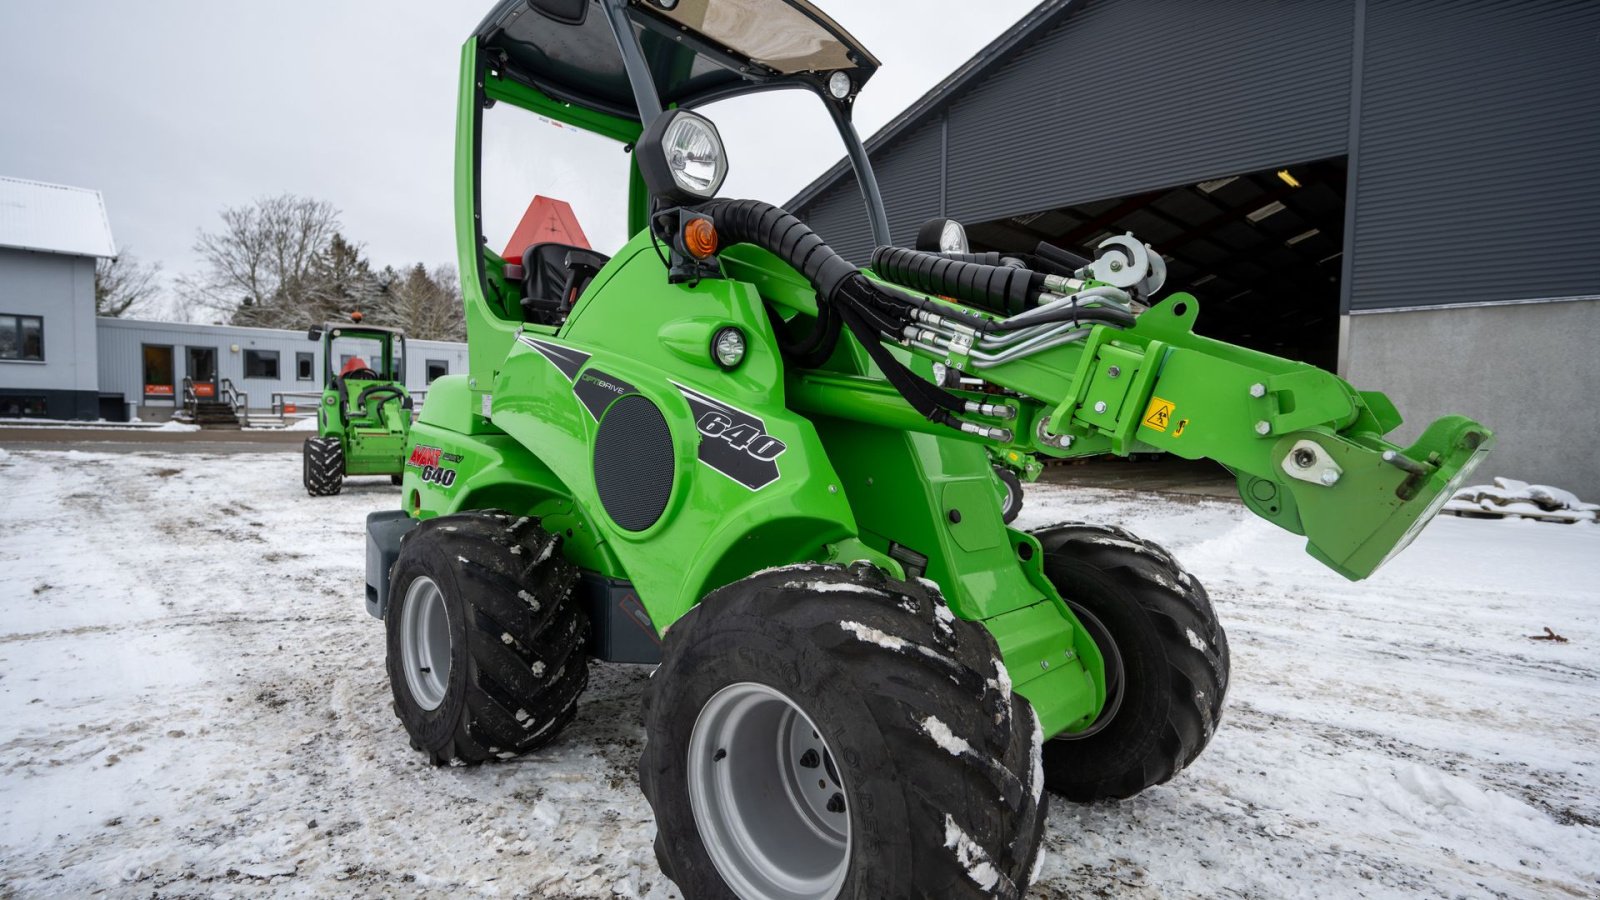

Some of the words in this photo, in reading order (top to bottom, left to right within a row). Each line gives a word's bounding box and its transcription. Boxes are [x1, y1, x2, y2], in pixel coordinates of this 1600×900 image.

[581, 373, 625, 395] OPTIDRIVE
[696, 411, 788, 462] 640
[406, 443, 442, 470] AVANT
[421, 465, 457, 489] 640
